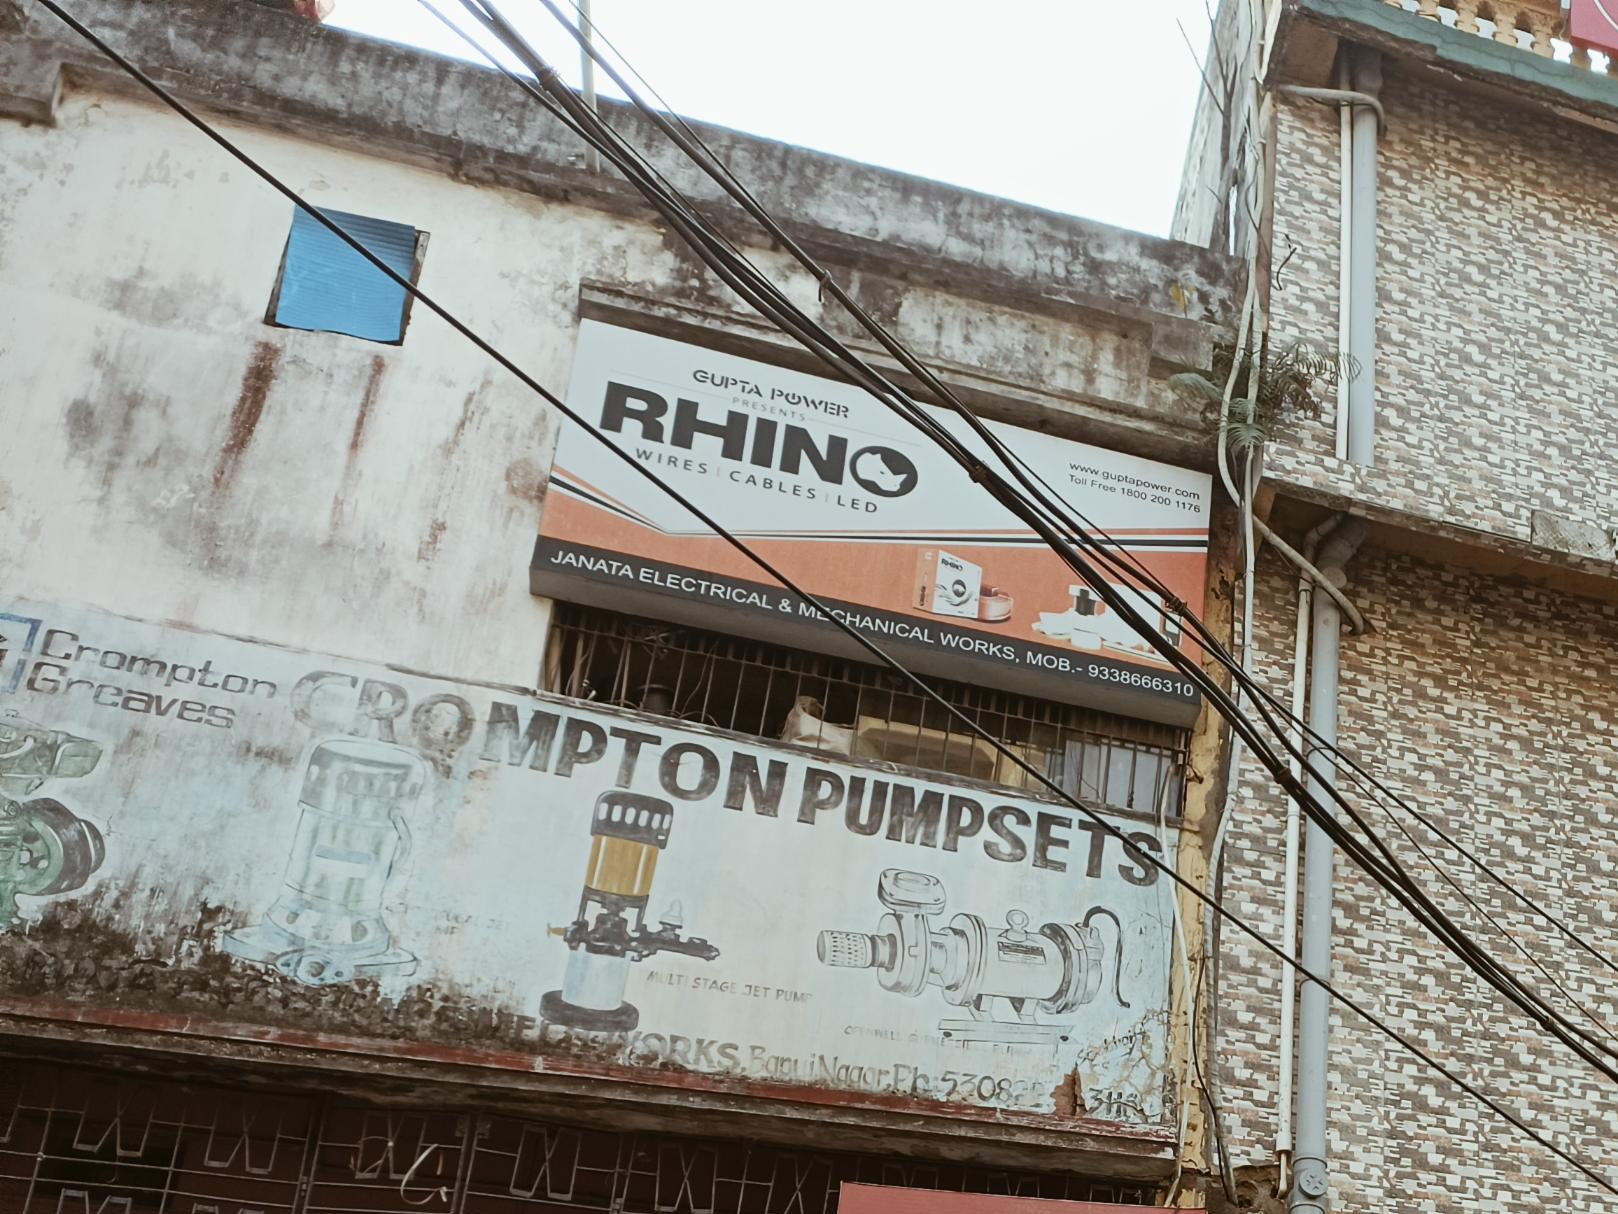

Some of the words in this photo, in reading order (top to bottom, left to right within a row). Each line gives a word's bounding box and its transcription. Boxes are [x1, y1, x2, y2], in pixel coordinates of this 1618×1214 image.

[692, 369, 763, 398] GUPTA
[771, 388, 850, 418] POWER
[732, 397, 807, 422] PRESENTS
[600, 381, 918, 498] RHINO
[635, 447, 709, 475] WIRES
[728, 469, 817, 500] CABLES
[837, 495, 879, 514] LED
[1069, 462, 1200, 500] www.guptapower.com
[1069, 474, 1088, 487] Toll
[1091, 480, 1117, 494] Free
[1121, 487, 1148, 500] 1800
[1151, 494, 1172, 506] 200
[1175, 500, 1201, 513] 1176
[550, 549, 635, 580] JANATA
[638, 567, 774, 610] ELECTRICAL
[778, 598, 793, 613] &
[798, 602, 935, 644] MECHANICAL
[940, 631, 1021, 664] WORKS,
[1088, 664, 1194, 698] 9338666310
[26, 661, 237, 729] Greaves
[39, 628, 278, 699] Crompton
[291, 669, 789, 818] CROMPTON
[797, 765, 1163, 887] PUMPSETS
[692, 977, 738, 995] STAGE
[745, 984, 771, 1000] JET
